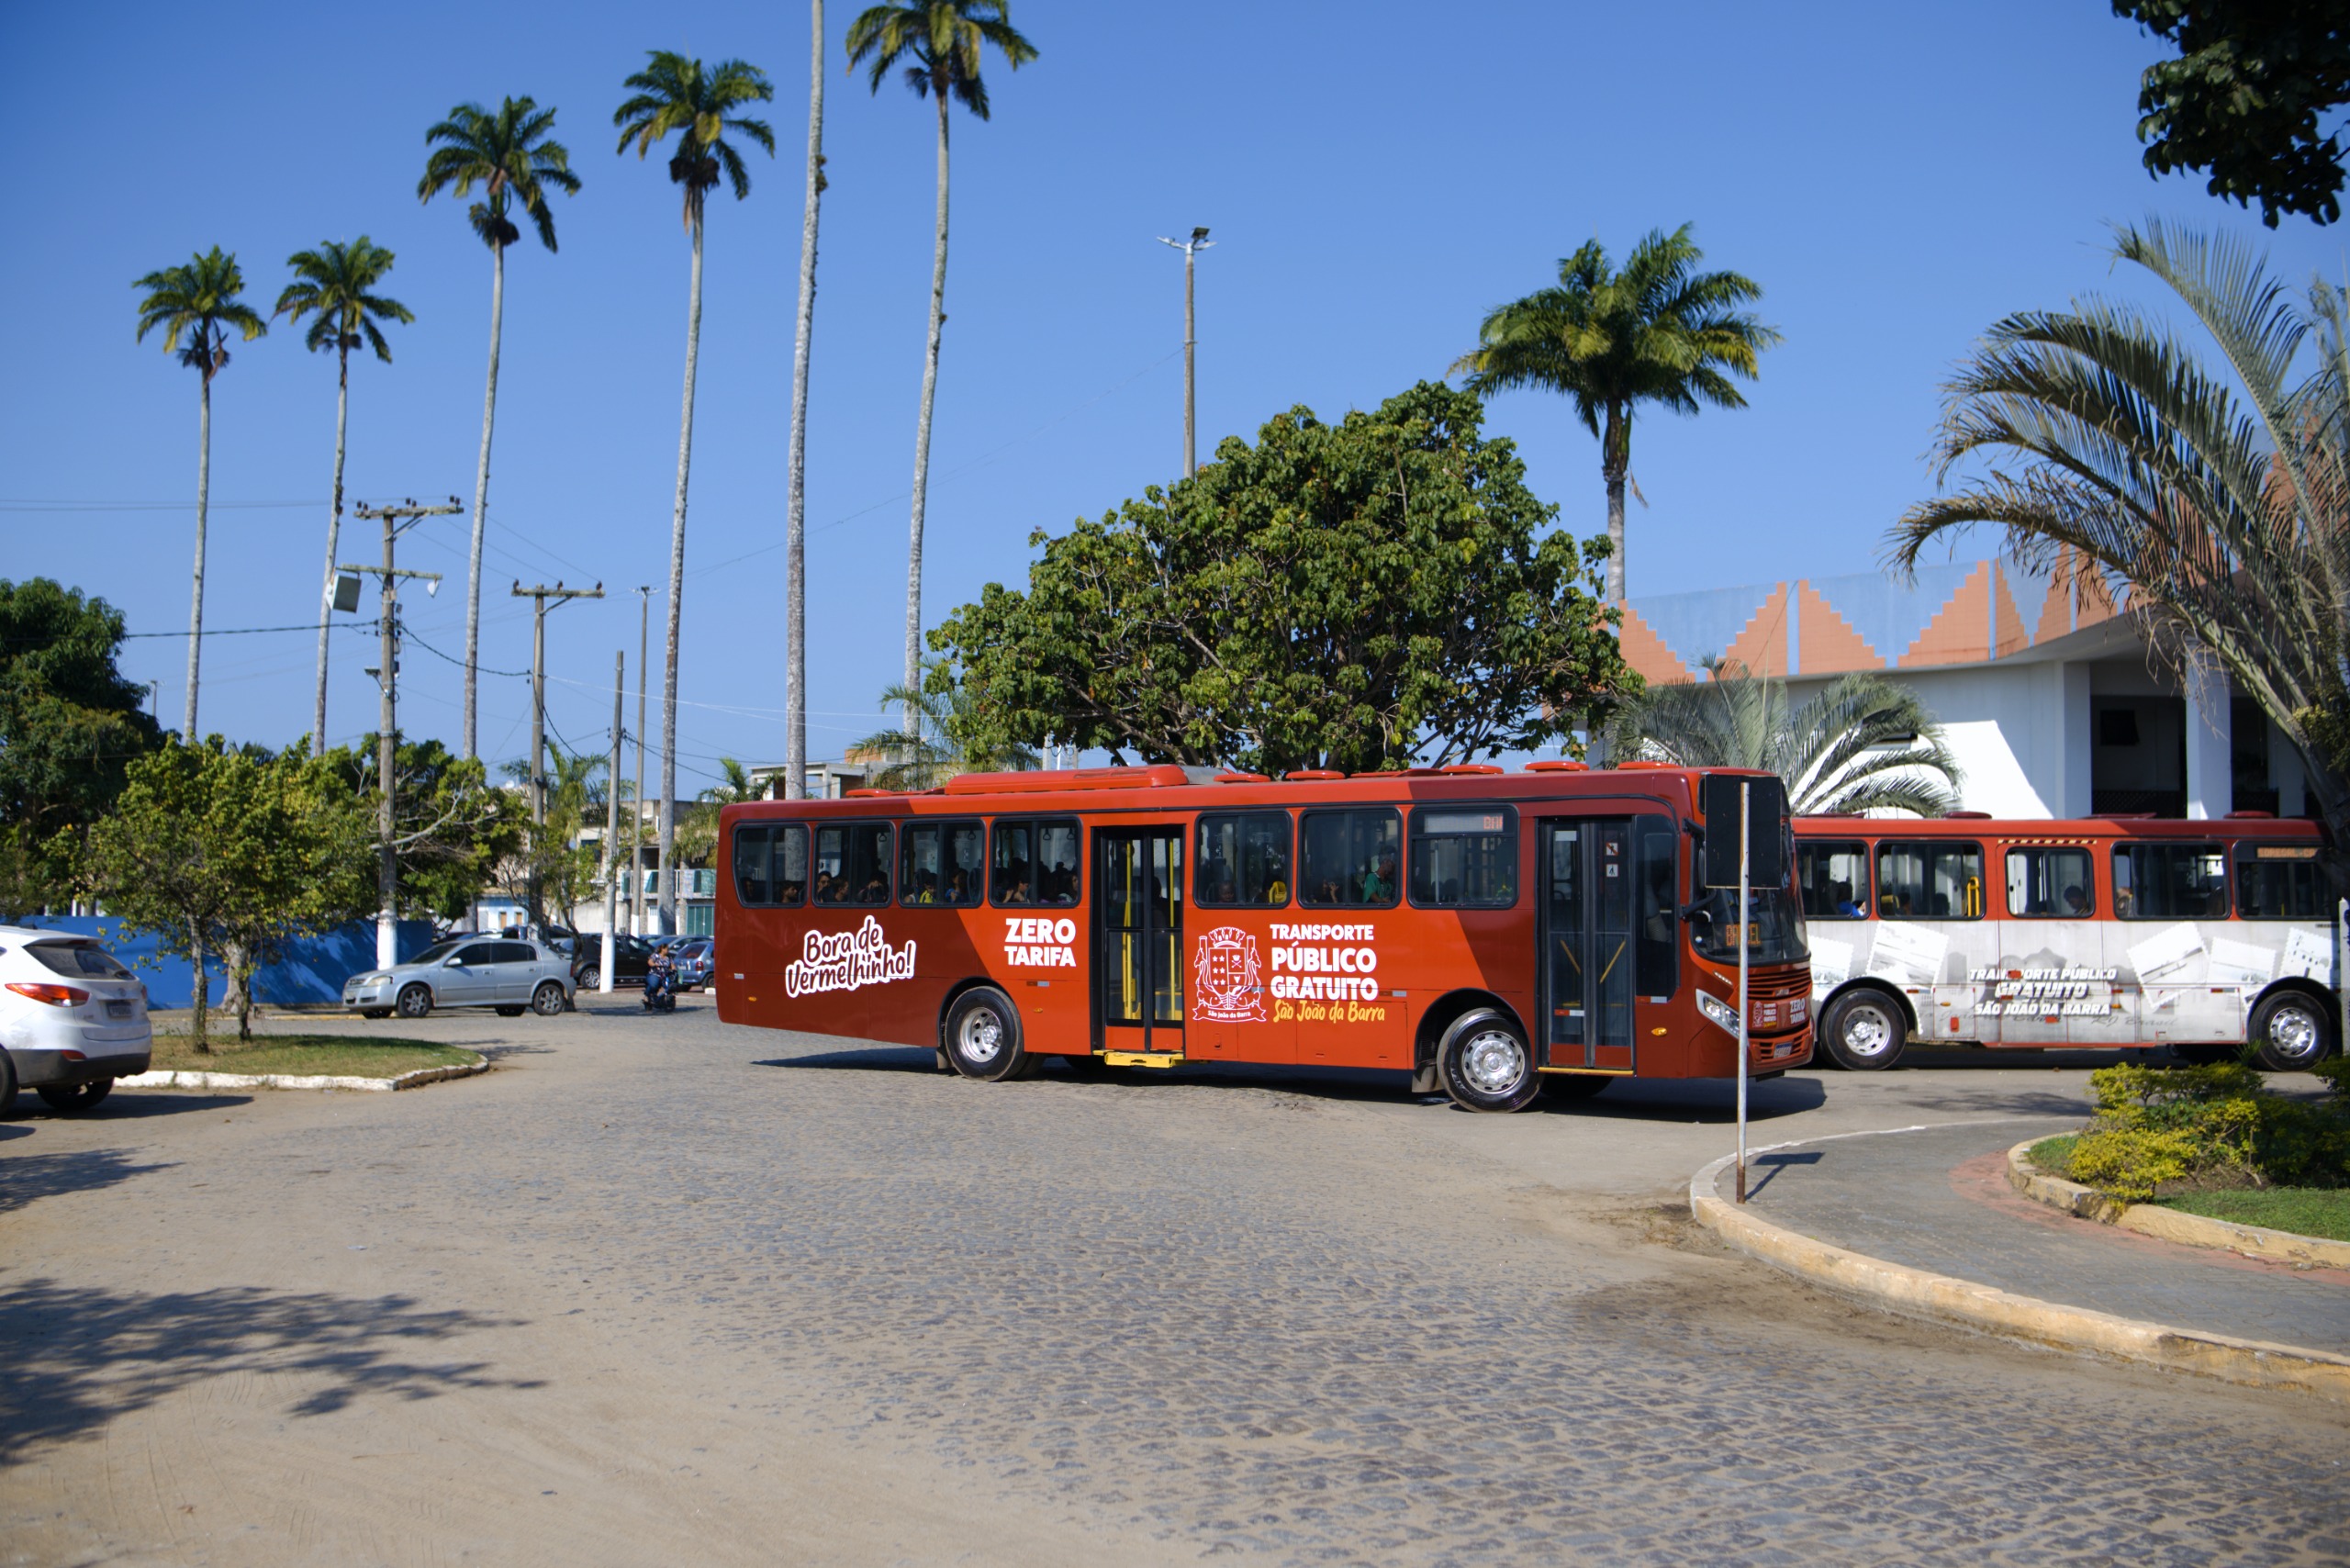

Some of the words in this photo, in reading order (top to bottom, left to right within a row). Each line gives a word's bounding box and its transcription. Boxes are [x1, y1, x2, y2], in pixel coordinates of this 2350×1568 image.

[805, 932, 852, 964] Bora
[857, 917, 880, 953] de
[1004, 918, 1077, 945] ZERO
[1270, 924, 1374, 940] TRANSPORTE
[787, 941, 913, 995] Vermelhinho!
[1003, 946, 1077, 967] TARIFA
[1271, 940, 1377, 973] PÚBLICO
[2060, 963, 2117, 980] PÚBLICO
[1270, 975, 1378, 1001] GRATUITO
[1994, 981, 2089, 998] GRATUITO
[1273, 999, 1293, 1023] São
[1296, 1000, 1326, 1022] João
[1329, 1000, 1344, 1024] da
[1348, 1001, 1385, 1023] Barra
[1789, 998, 1806, 1014] ZERO
[1975, 1000, 2001, 1015] SÃO
[2004, 999, 2039, 1015] JOÃO
[2040, 1003, 2059, 1015] DA
[2062, 1003, 2110, 1015] BARRA
